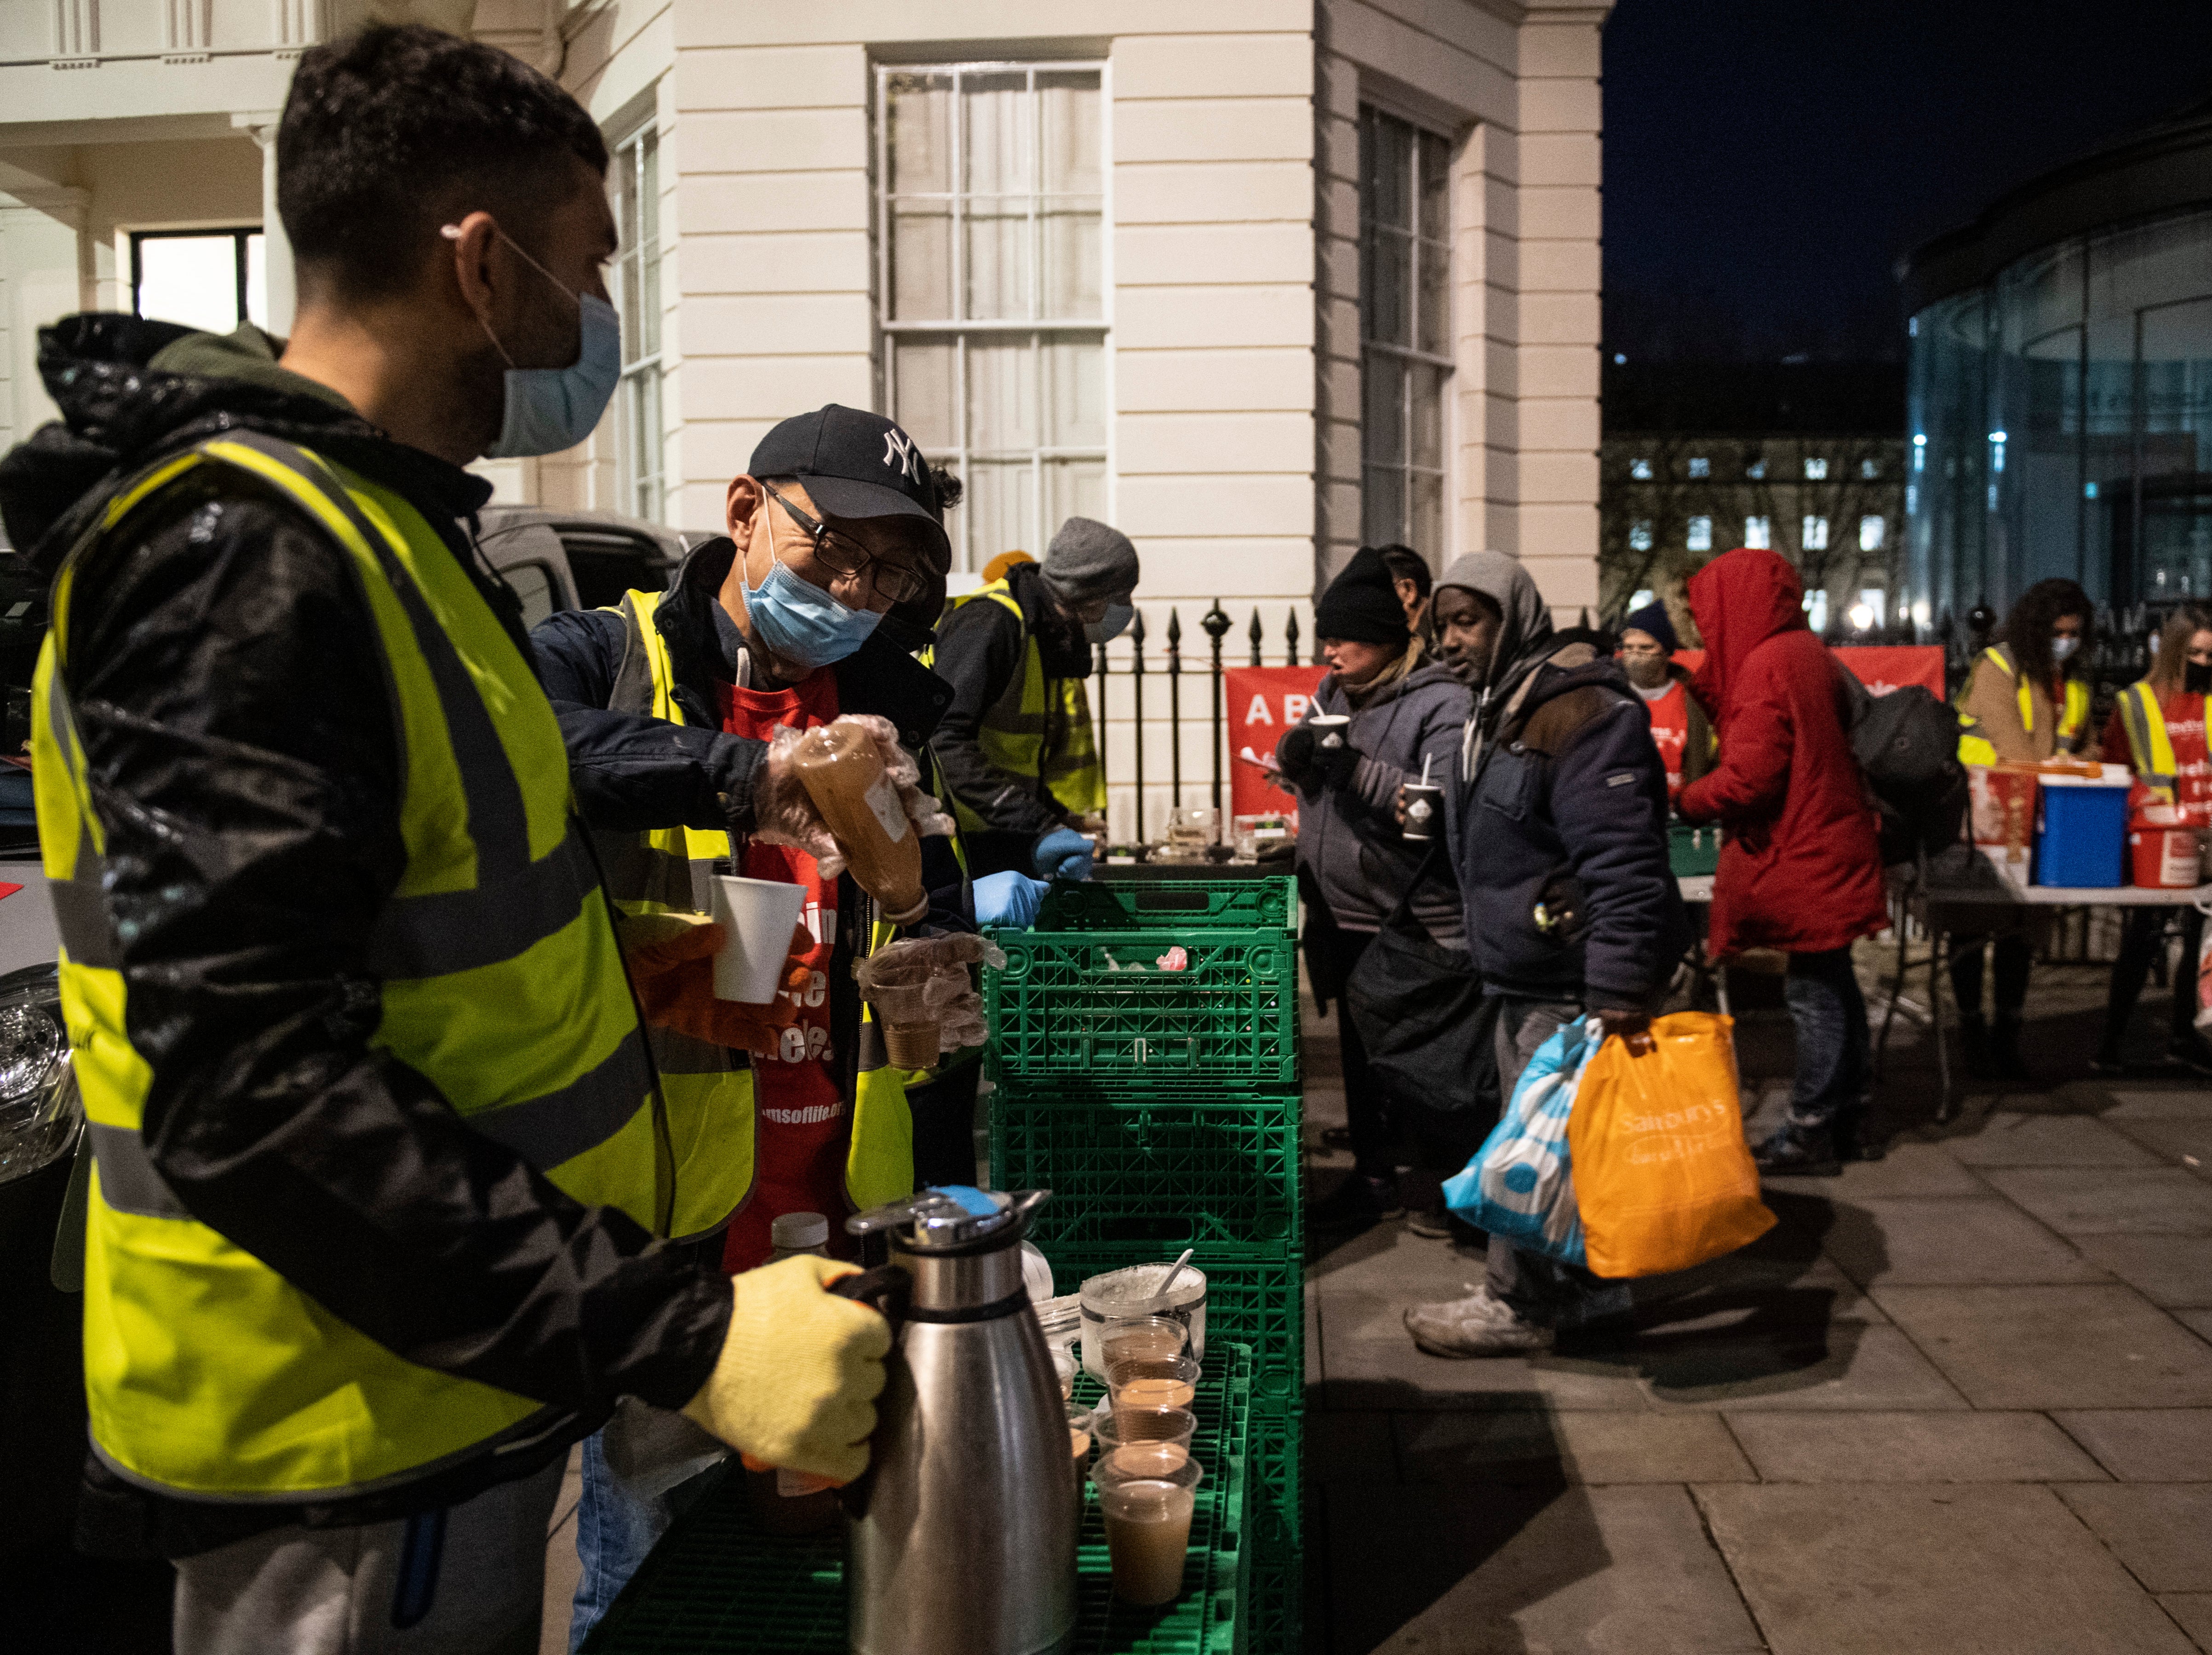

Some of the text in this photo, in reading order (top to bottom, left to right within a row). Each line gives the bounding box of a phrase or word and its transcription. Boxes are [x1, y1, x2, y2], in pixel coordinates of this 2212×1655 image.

[883, 428, 921, 485] NY
[797, 901, 837, 944] in
[762, 1102, 847, 1124] msoflife.or
